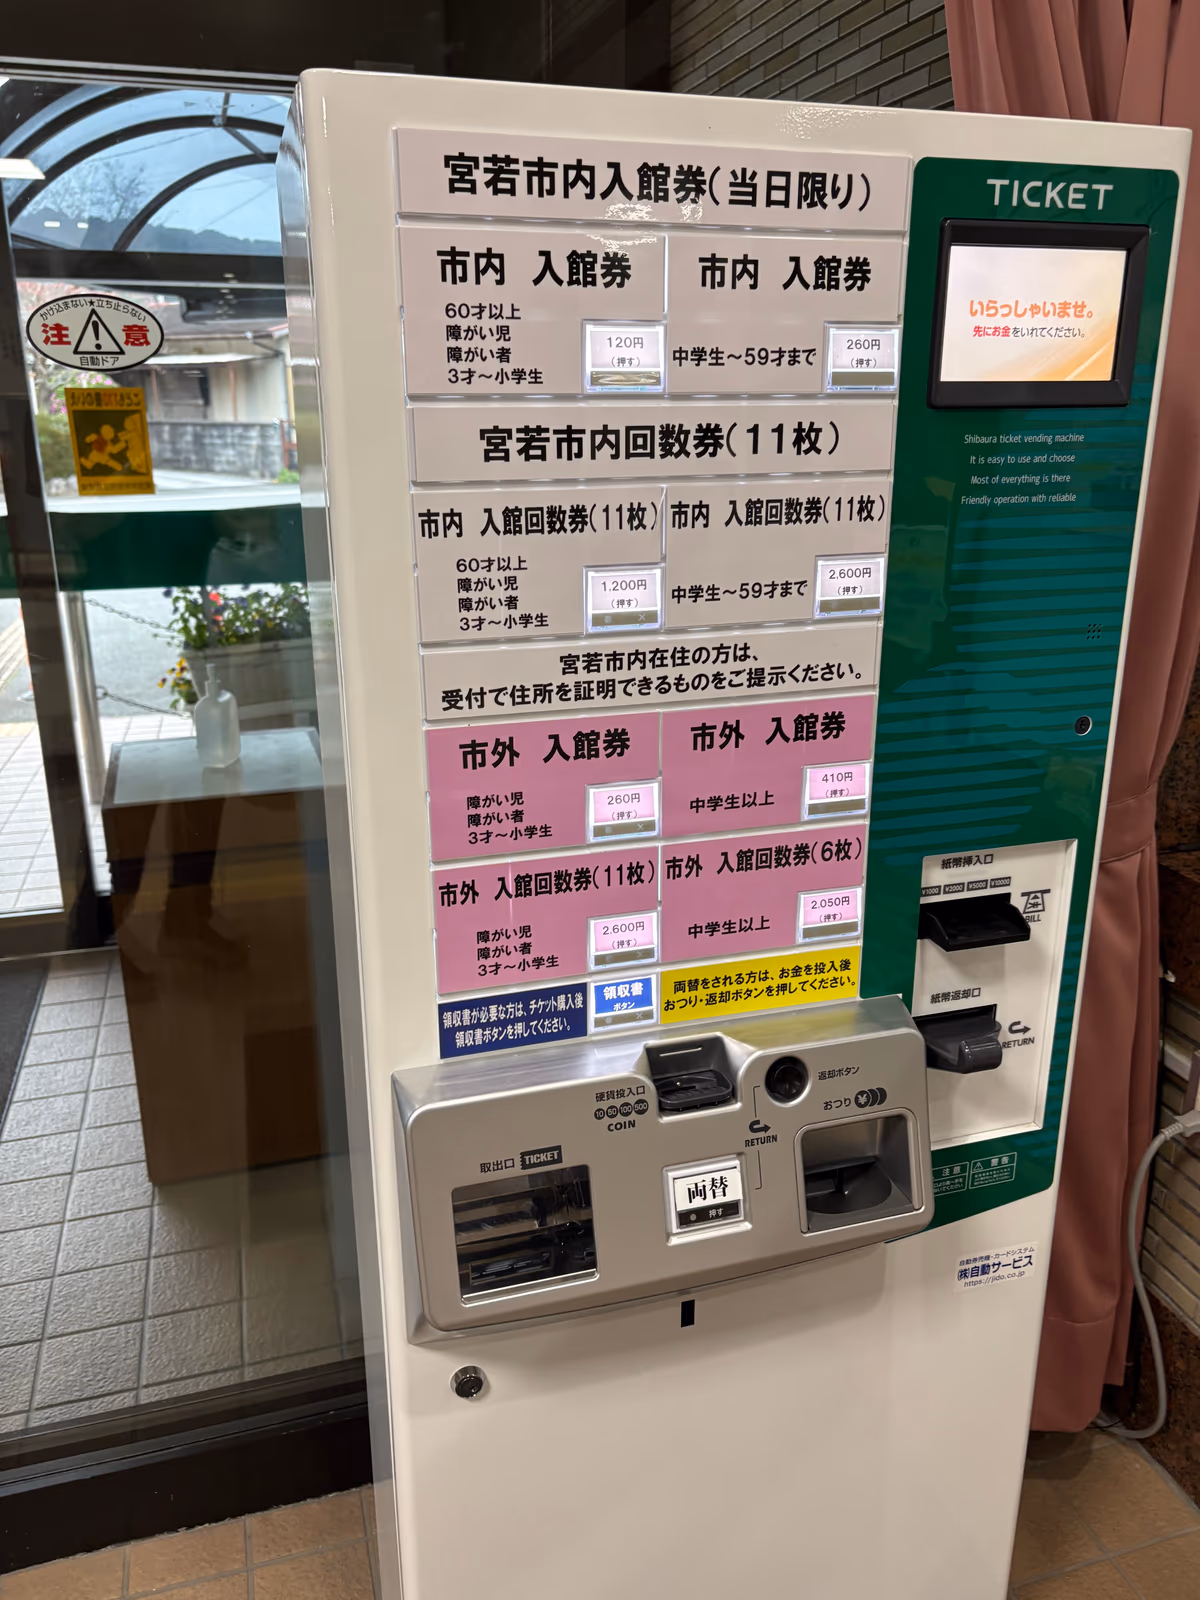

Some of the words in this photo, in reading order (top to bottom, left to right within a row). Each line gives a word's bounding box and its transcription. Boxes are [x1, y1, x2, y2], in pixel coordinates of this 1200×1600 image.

[986, 178, 1114, 211] TICKET
[436, 246, 506, 286] 市内
[532, 249, 632, 289] 入館券
[698, 253, 759, 290] 市内
[782, 255, 872, 292] 入館券
[444, 302, 522, 321] 60才以上
[969, 299, 1094, 320] いらっしゃいませ。
[445, 324, 512, 342] 障がい児
[972, 325, 1085, 339] 先にお金をいれてください。
[606, 336, 645, 349] 120円
[846, 339, 881, 351] 260円
[79, 355, 120, 367] 自動ドア
[446, 346, 512, 364] 障がい者
[610, 356, 641, 368] (押す)
[849, 357, 878, 369] (押す)
[964, 434, 998, 444] Shibaura
[1000, 434, 1022, 443] ticket
[1024, 434, 1053, 445] vending
[1054, 433, 1085, 443] machine
[970, 455, 977, 464] It
[978, 454, 985, 464] is
[987, 455, 1005, 466] easy
[1007, 455, 1016, 464] to
[1017, 455, 1031, 464] use
[1033, 454, 1047, 463] and
[1049, 454, 1076, 463] choose
[970, 475, 989, 485] Most
[991, 475, 999, 484] of
[1001, 474, 1041, 485] everything
[1042, 474, 1049, 483] is
[1051, 473, 1071, 483] there
[961, 495, 992, 506] Friendly
[993, 494, 1029, 506] operation
[1031, 493, 1047, 503] with
[1048, 493, 1077, 503] reliable
[418, 508, 464, 539] 市内
[670, 500, 710, 530] 市内
[455, 555, 528, 573] 60才以上
[457, 575, 519, 593] 障がい児
[837, 584, 863, 596] (押す)
[458, 595, 519, 613] 障がい者
[610, 597, 639, 609] (押す)
[559, 642, 759, 676] 宮若市内在住の方は、
[441, 661, 862, 712] 受付で住所を証明できるものをご提示ください。
[690, 719, 745, 752] 市外
[764, 710, 846, 745] 入館券
[458, 736, 521, 771] 市外
[542, 727, 631, 764] 入館券
[821, 771, 853, 783] 410円
[466, 791, 525, 811] 障がい児
[607, 792, 641, 806] 260円
[689, 790, 775, 814] 中学生以上
[824, 788, 850, 798] (押す)
[467, 809, 525, 828] 障がい者
[611, 809, 638, 821] (押す)
[665, 853, 703, 881] 市外
[941, 853, 994, 870] 紙幣挿入口
[438, 879, 480, 908] 市外
[819, 911, 843, 924] (押す)
[1025, 913, 1042, 924] BILL
[476, 925, 532, 945] 障がい児
[687, 915, 771, 939] 中学生以上
[477, 942, 533, 961] 障がい者
[611, 937, 638, 950] (押す)
[673, 958, 852, 995] 両替をされる方は、お金を投入後
[603, 981, 644, 1001] 領収書
[663, 975, 857, 1012] おつり・返却ボタンを押してください。
[930, 987, 981, 1005] 紙幣返却口
[442, 991, 584, 1030] 領収書が必要な方は、チケット購入後
[613, 1001, 636, 1012] ボタン
[455, 1017, 571, 1049] 領収書ボタンを押してください。
[1001, 1036, 1036, 1049] RETURN
[817, 1066, 860, 1082] 返却ボタン
[595, 1085, 646, 1103] 硬貨投入口
[595, 1109, 605, 1119] 10
[607, 1107, 617, 1117] 50
[620, 1104, 633, 1115] 100
[634, 1101, 648, 1112] 500
[823, 1097, 851, 1111] おつり
[607, 1119, 636, 1132] COIN
[744, 1134, 778, 1148] RETURN
[479, 1158, 515, 1173] 取出口
[523, 1150, 560, 1166] TICKET
[686, 1175, 729, 1204] 両替
[708, 1207, 724, 1219] 押す
[963, 1269, 1026, 1288] https://jido.co.jp
